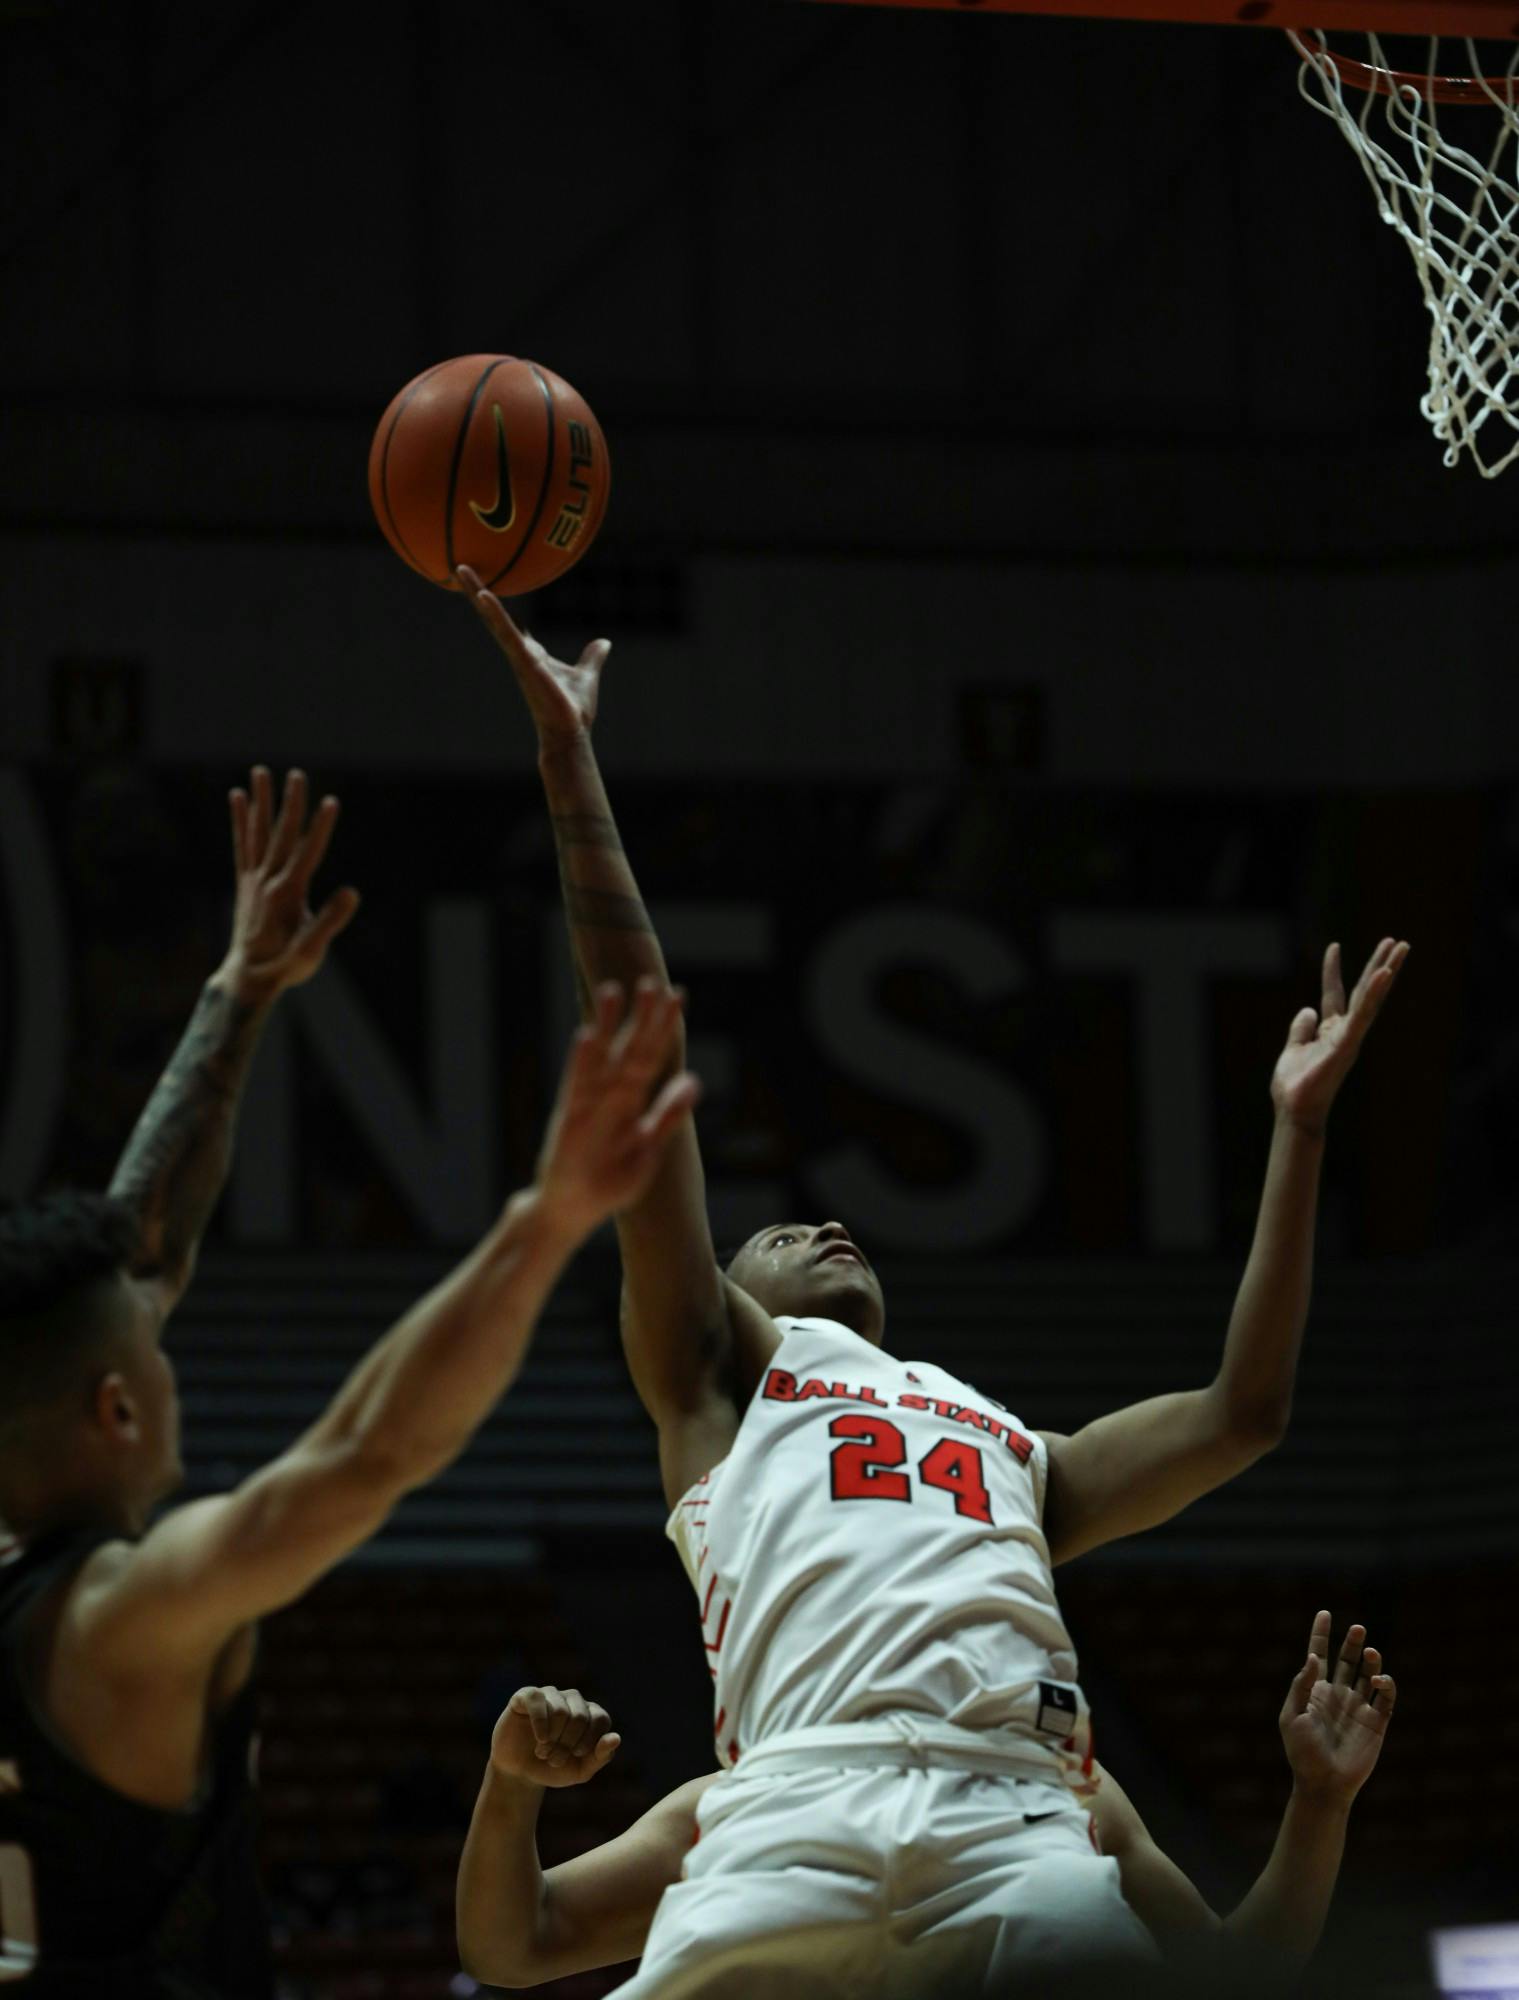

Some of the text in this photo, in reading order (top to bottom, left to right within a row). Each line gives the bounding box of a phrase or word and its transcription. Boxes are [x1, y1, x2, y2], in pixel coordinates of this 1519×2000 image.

[546, 419, 593, 551] ELITE
[763, 1369, 1034, 1464] BALL STATE
[828, 1414, 995, 1526] 24
